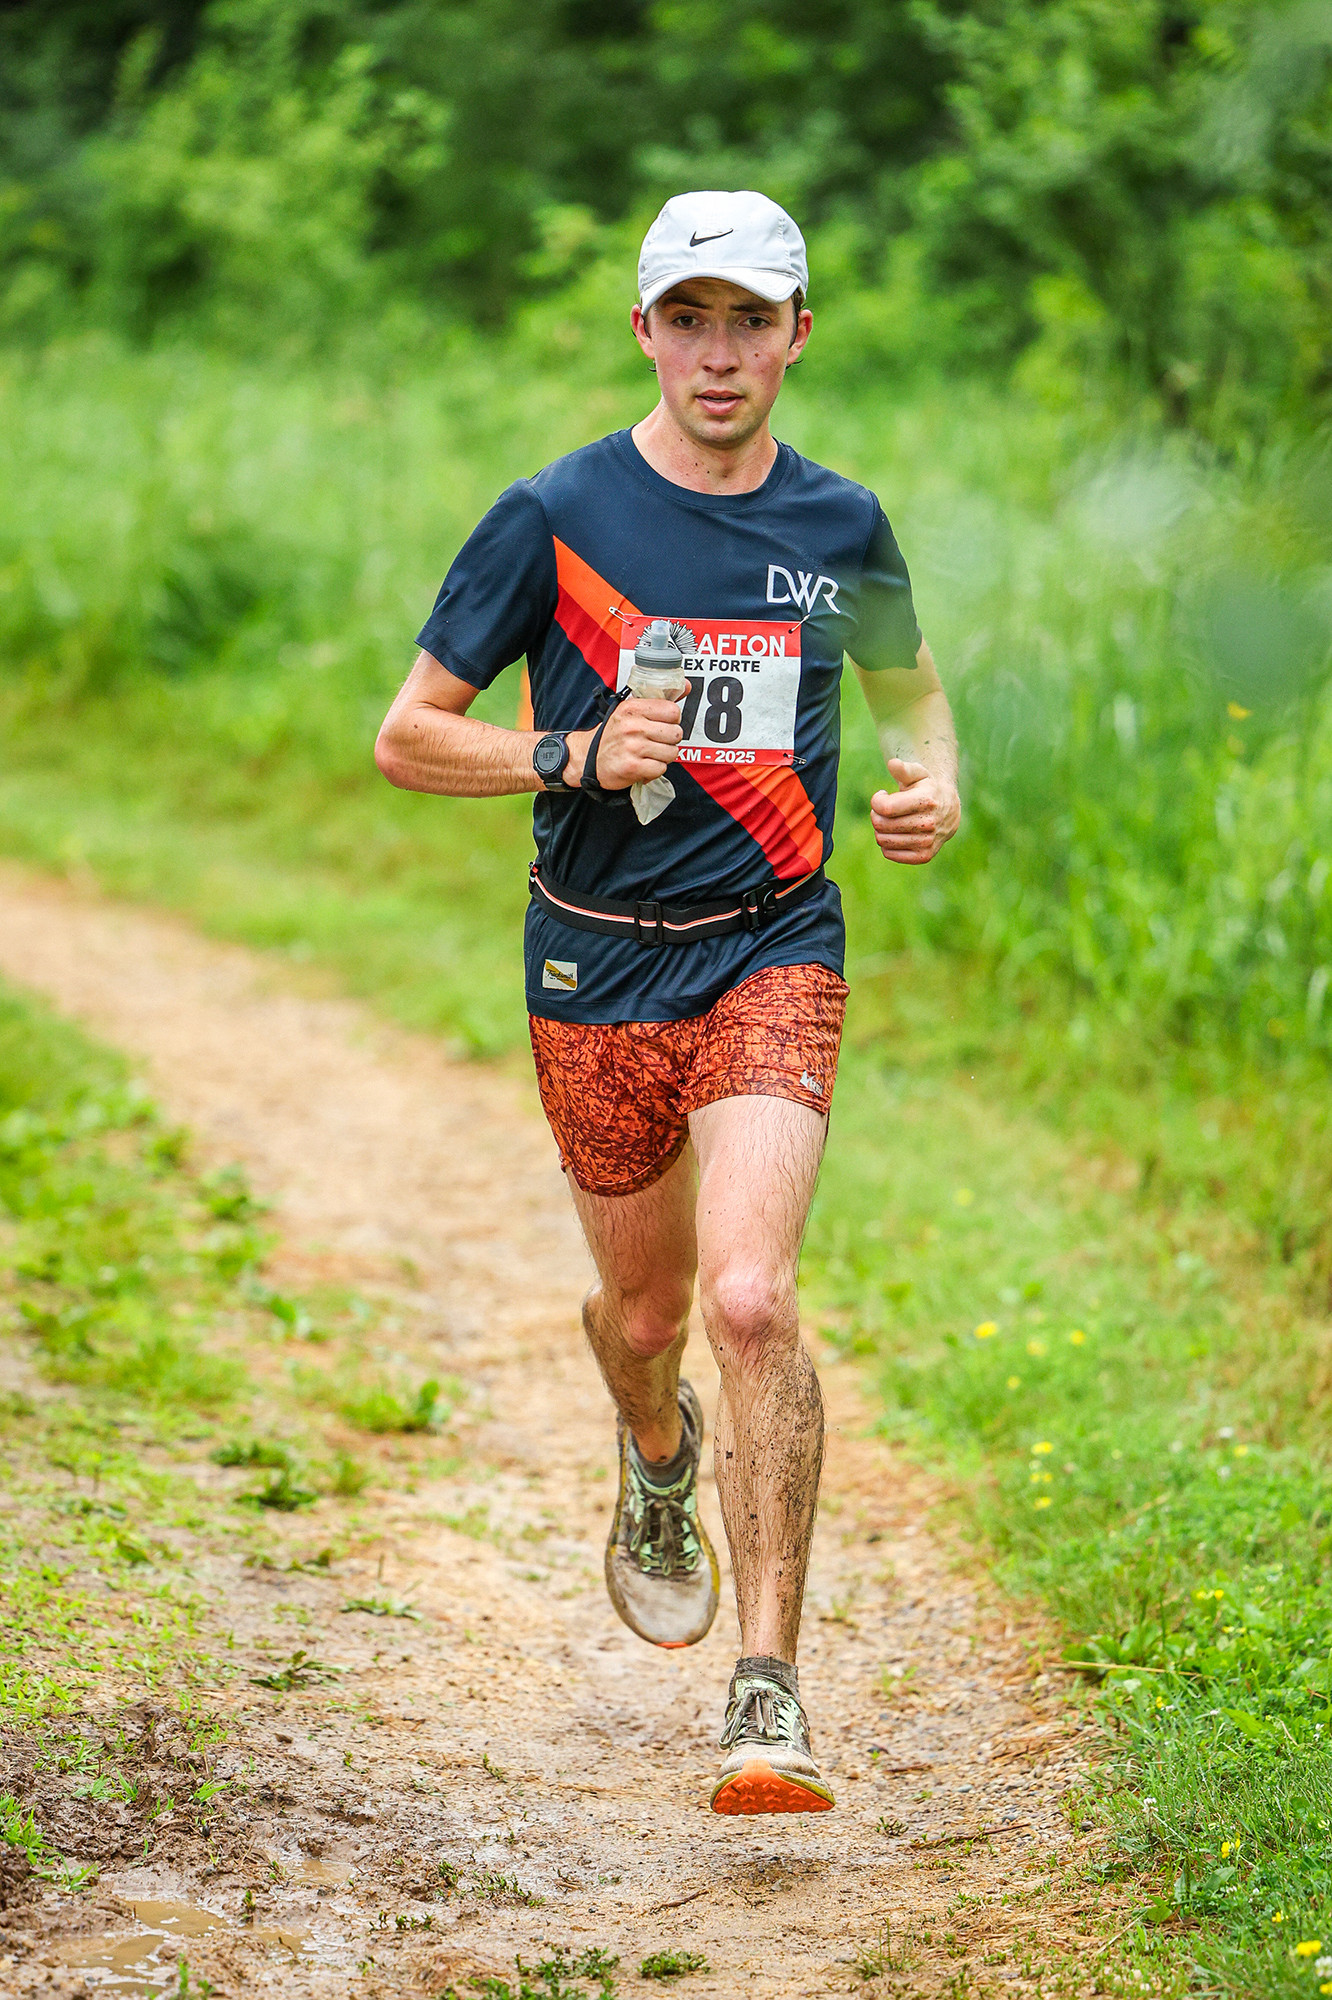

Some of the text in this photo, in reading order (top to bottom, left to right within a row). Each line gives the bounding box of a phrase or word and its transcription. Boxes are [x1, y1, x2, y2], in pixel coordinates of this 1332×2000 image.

[766, 564, 841, 614] DWR
[697, 633, 785, 657] AFTON
[682, 658, 760, 673] EX FORTE
[714, 750, 756, 764] 2025
